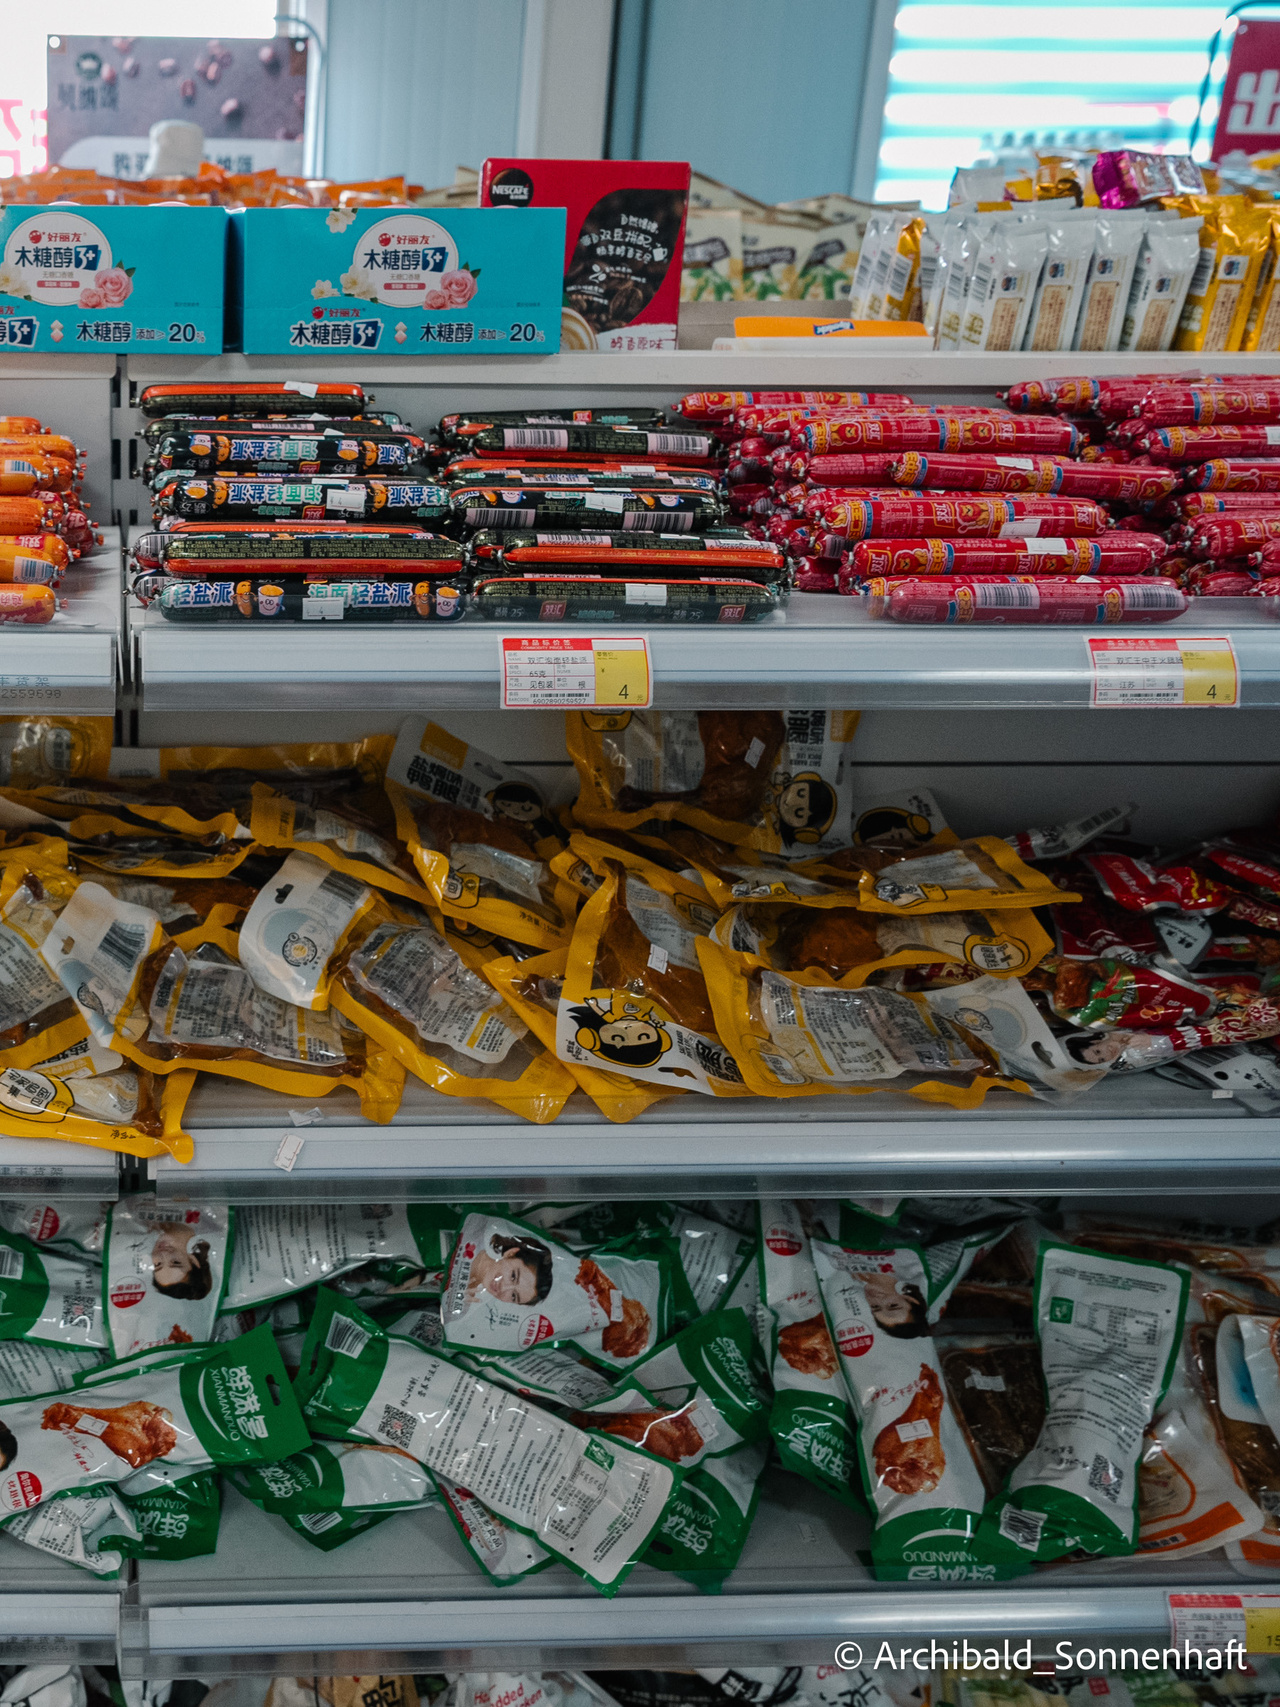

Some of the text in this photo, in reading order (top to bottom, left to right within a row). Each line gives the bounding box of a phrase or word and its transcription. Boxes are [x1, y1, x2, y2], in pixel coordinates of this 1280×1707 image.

[47, 231, 82, 243] 好丽友
[396, 234, 431, 246] 好丽友
[76, 321, 131, 343] 木糖醇
[419, 322, 475, 344] 木糖醇
[229, 439, 320, 462] 泡面轻盐派
[229, 483, 322, 505] 泡面轻盐派
[869, 552, 888, 575] 双汇
[308, 582, 412, 608] 泡面轻盐派
[543, 603, 564, 618] 双汇
[721, 606, 743, 621] 双汇
[521, 639, 572, 647] 商品标价签
[528, 670, 547, 678] 65克
[529, 680, 554, 690] 见包装
[618, 684, 630, 700] 4
[1206, 684, 1217, 700] 4
[209, 1367, 240, 1442] XIANMANDUO
[224, 1365, 269, 1440] 鲜满多
